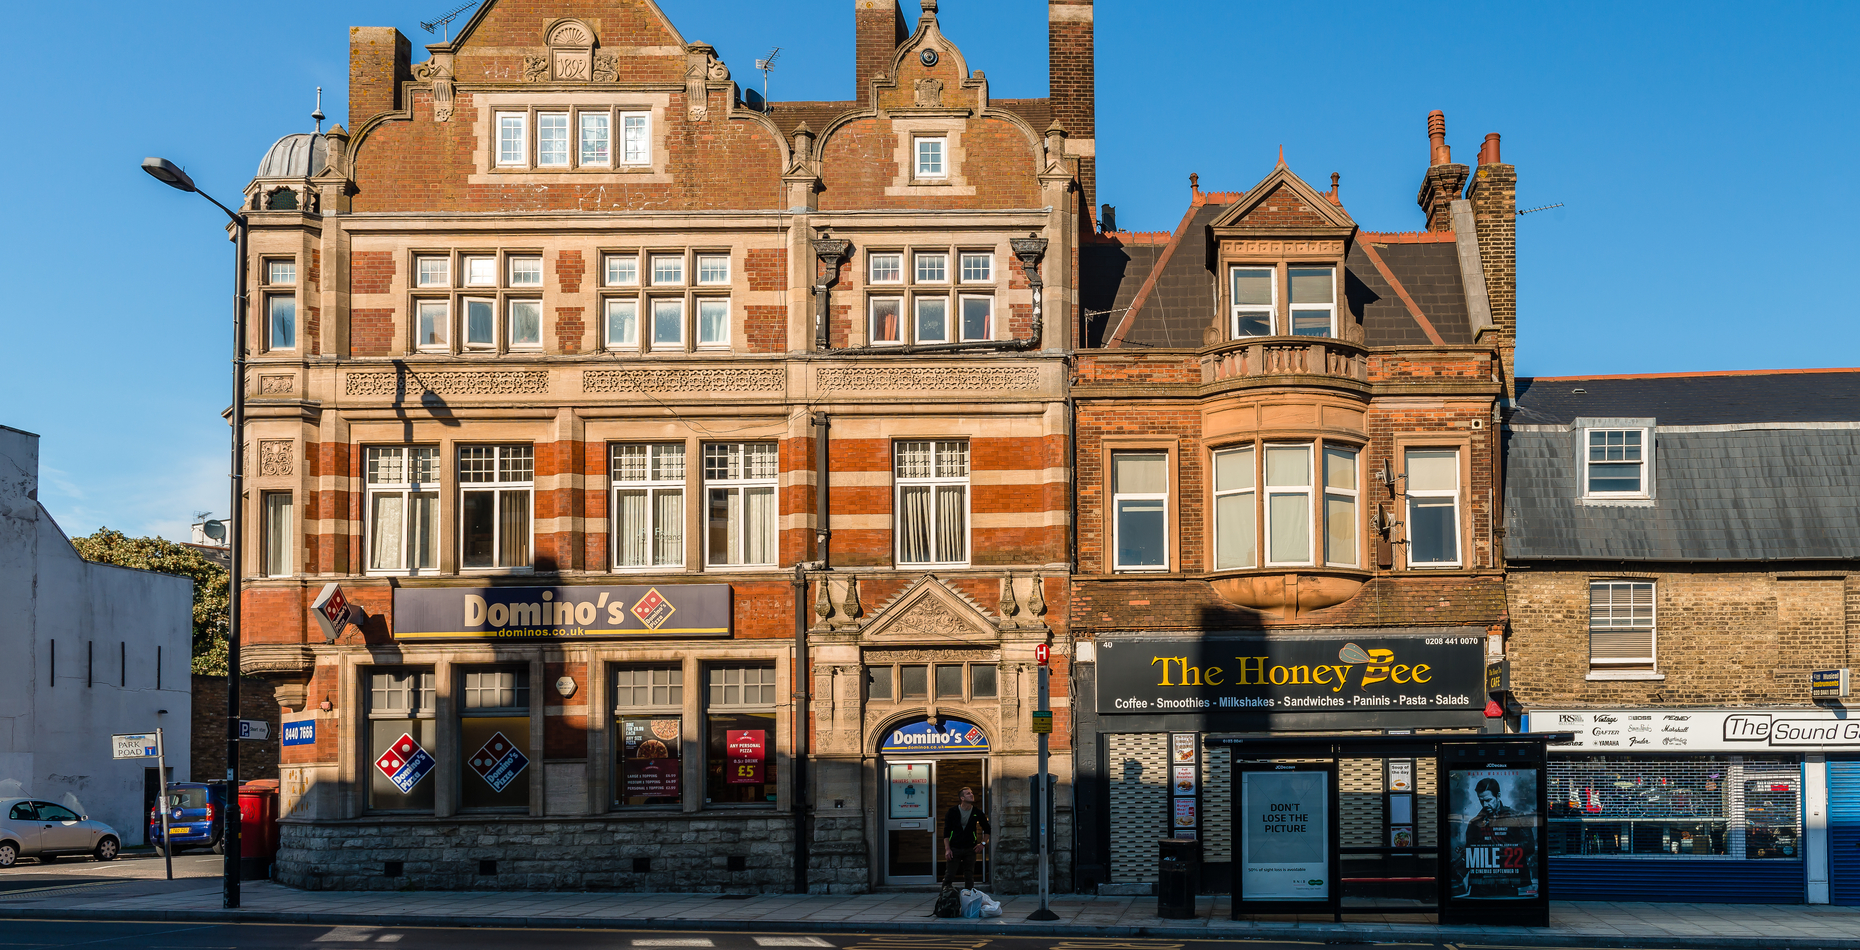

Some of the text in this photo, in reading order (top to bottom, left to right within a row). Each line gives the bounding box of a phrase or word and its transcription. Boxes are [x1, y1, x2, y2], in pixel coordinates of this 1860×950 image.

[558, 59, 587, 79] 1892
[464, 590, 625, 627] Domino's
[498, 627, 585, 638] dominos.co.uk
[1103, 641, 1113, 649] 40
[1425, 637, 1479, 645] 0208 441 0070
[1036, 646, 1047, 660] H
[1151, 648, 1433, 693] The Honey Bee
[1114, 697, 1148, 709] Coffee
[1156, 697, 1210, 709] Smoothies
[1219, 696, 1275, 708] Milkshakes
[1283, 696, 1345, 707] Sandwiches
[1353, 695, 1391, 706] Paninis
[1399, 695, 1427, 706] Pasta
[1435, 694, 1470, 706] Salads
[1558, 714, 1575, 722] PRS
[1593, 714, 1618, 724] Vintage
[284, 726, 313, 740] 8440 7666
[1660, 724, 1690, 732] Marshall
[1730, 718, 1860, 740] The Sound G
[893, 728, 962, 745] Domino's
[1628, 736, 1651, 746] Fender
[118, 740, 140, 748] PARK
[393, 753, 426, 785] Domino's
[486, 752, 519, 783] Domino's
[400, 770, 421, 791] Pizza
[493, 770, 514, 790] Pizza
[1270, 803, 1300, 812] DON'T
[1262, 814, 1308, 822] LOSE THE
[1264, 824, 1306, 833] PICTURE
[1465, 847, 1524, 868] MILE 22
